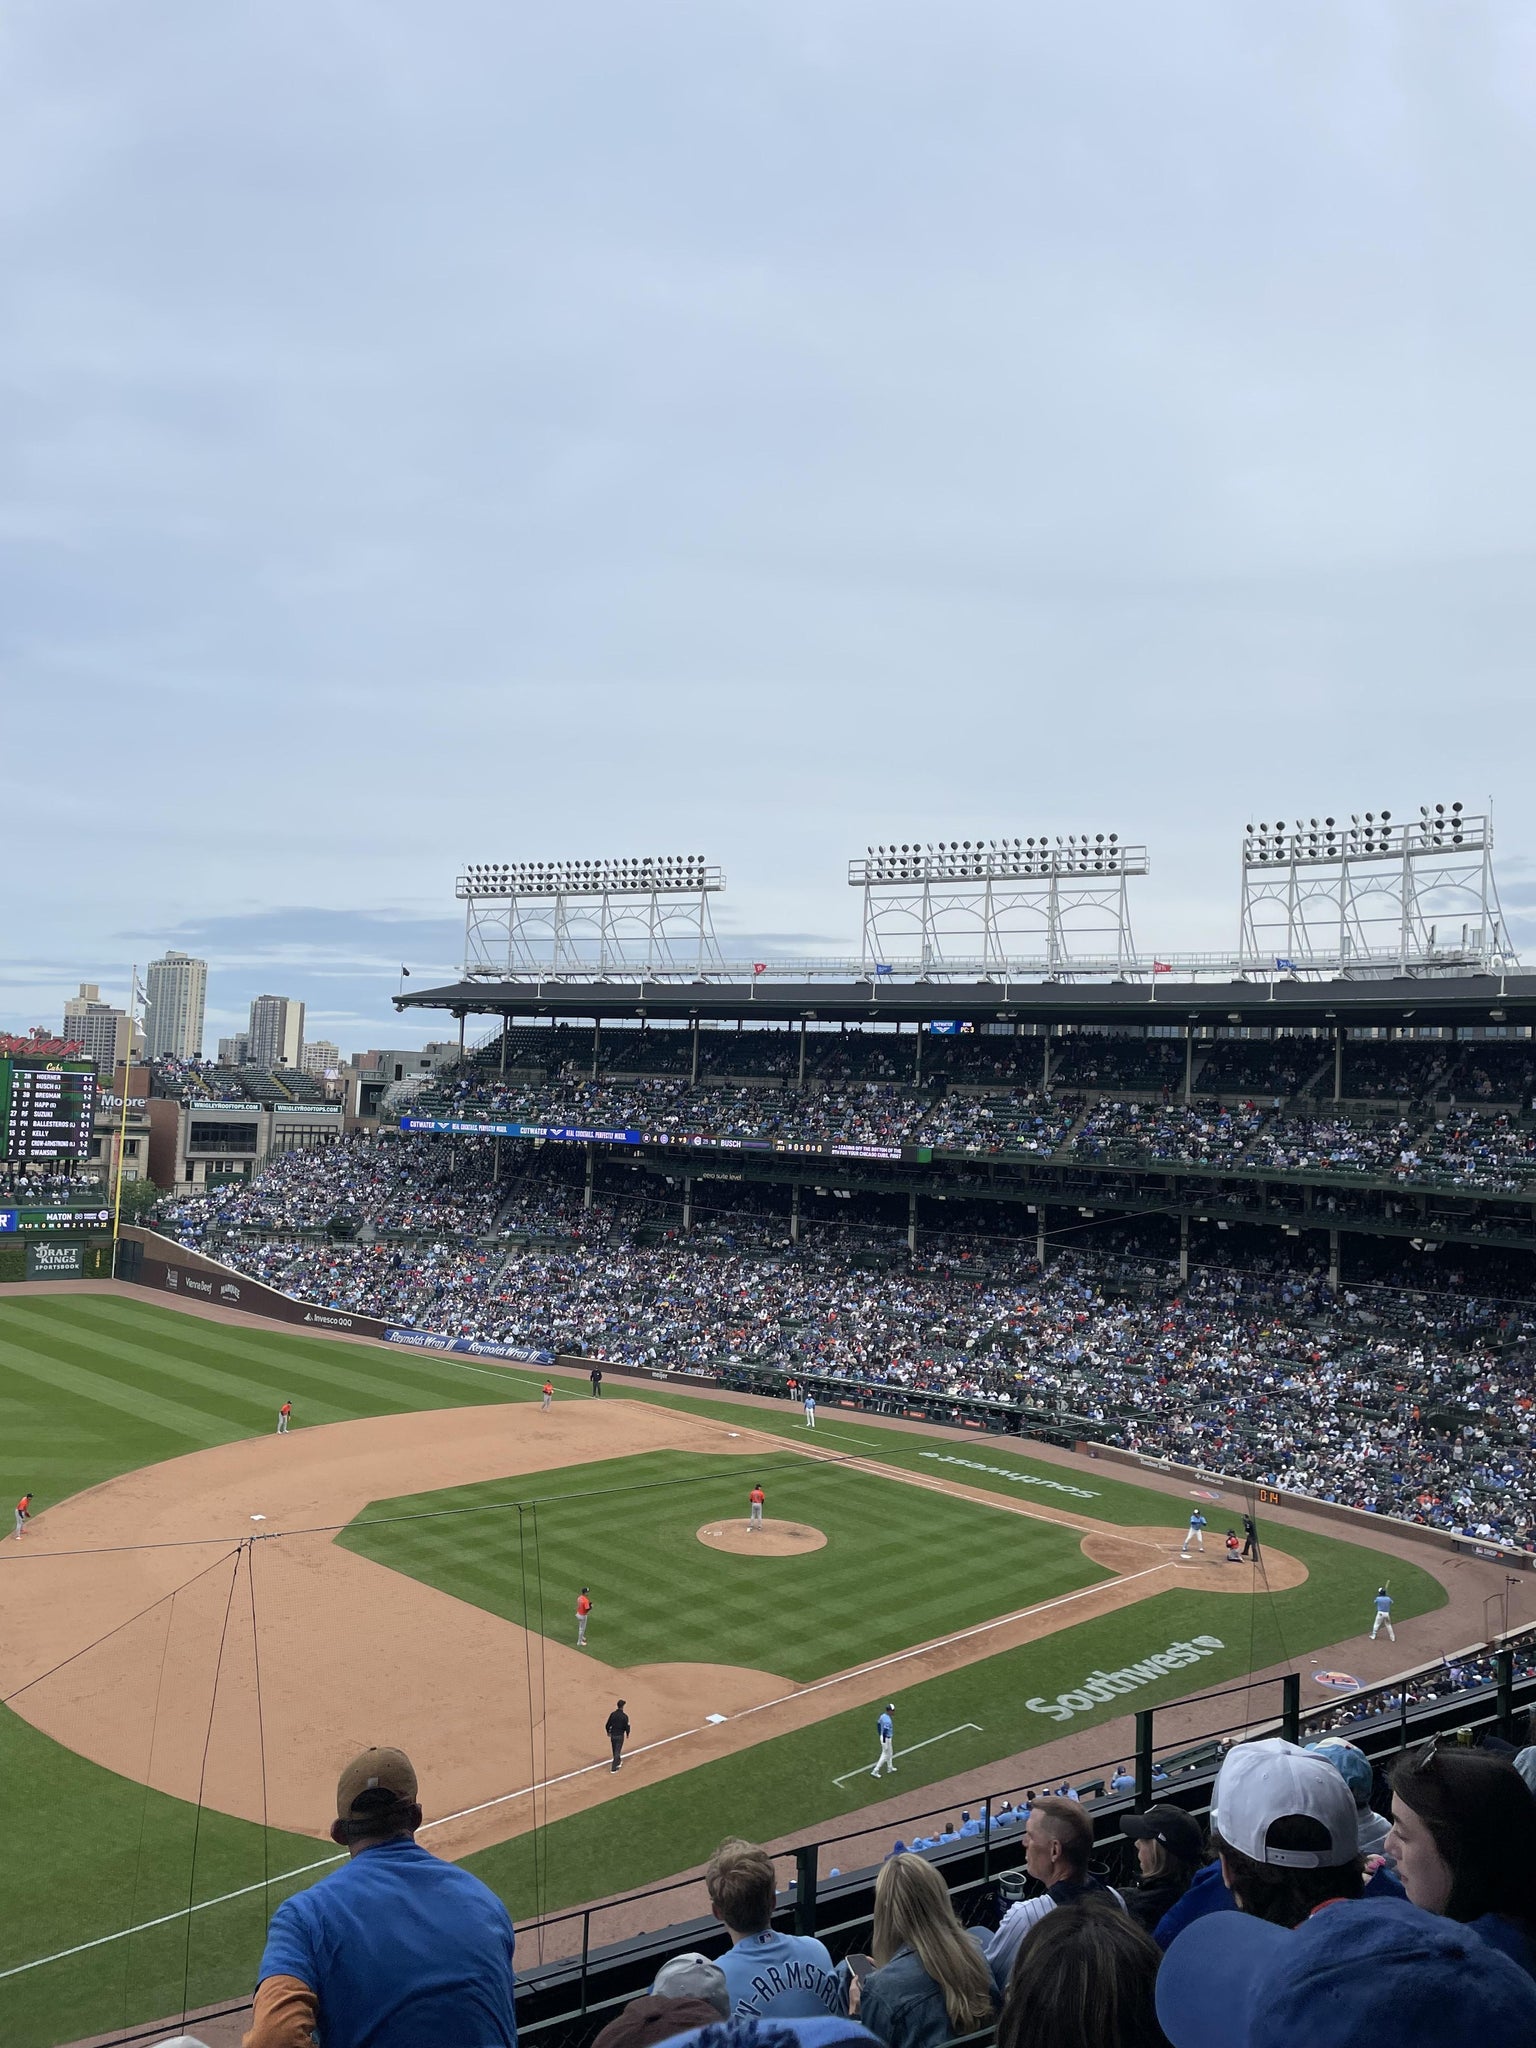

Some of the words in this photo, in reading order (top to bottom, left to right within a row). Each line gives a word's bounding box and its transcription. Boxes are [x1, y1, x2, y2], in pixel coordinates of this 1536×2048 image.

[46, 1062, 63, 1071] Cubs
[100, 1094, 145, 1107] Moore
[194, 1102, 258, 1110] WRIGLEYROOFTOPS.COM
[520, 1127, 548, 1135] CUTWATER
[721, 1140, 741, 1148] BUSCH
[35, 1248, 78, 1258] DRAFT
[40, 1256, 76, 1264] KINGS
[185, 1277, 201, 1290] Vienna
[220, 1283, 240, 1299] MARQUEE
[314, 1314, 337, 1324] Invesco
[339, 1318, 352, 1327] QQQ
[390, 1332, 424, 1344] Reynolds
[424, 1336, 445, 1349] Wrap
[468, 1342, 506, 1355] Reynolds
[505, 1347, 528, 1360] Wrap
[937, 1455, 1102, 1499] Southwest
[1270, 1491, 1278, 1504] 14
[1025, 1642, 1213, 1721] Southwest
